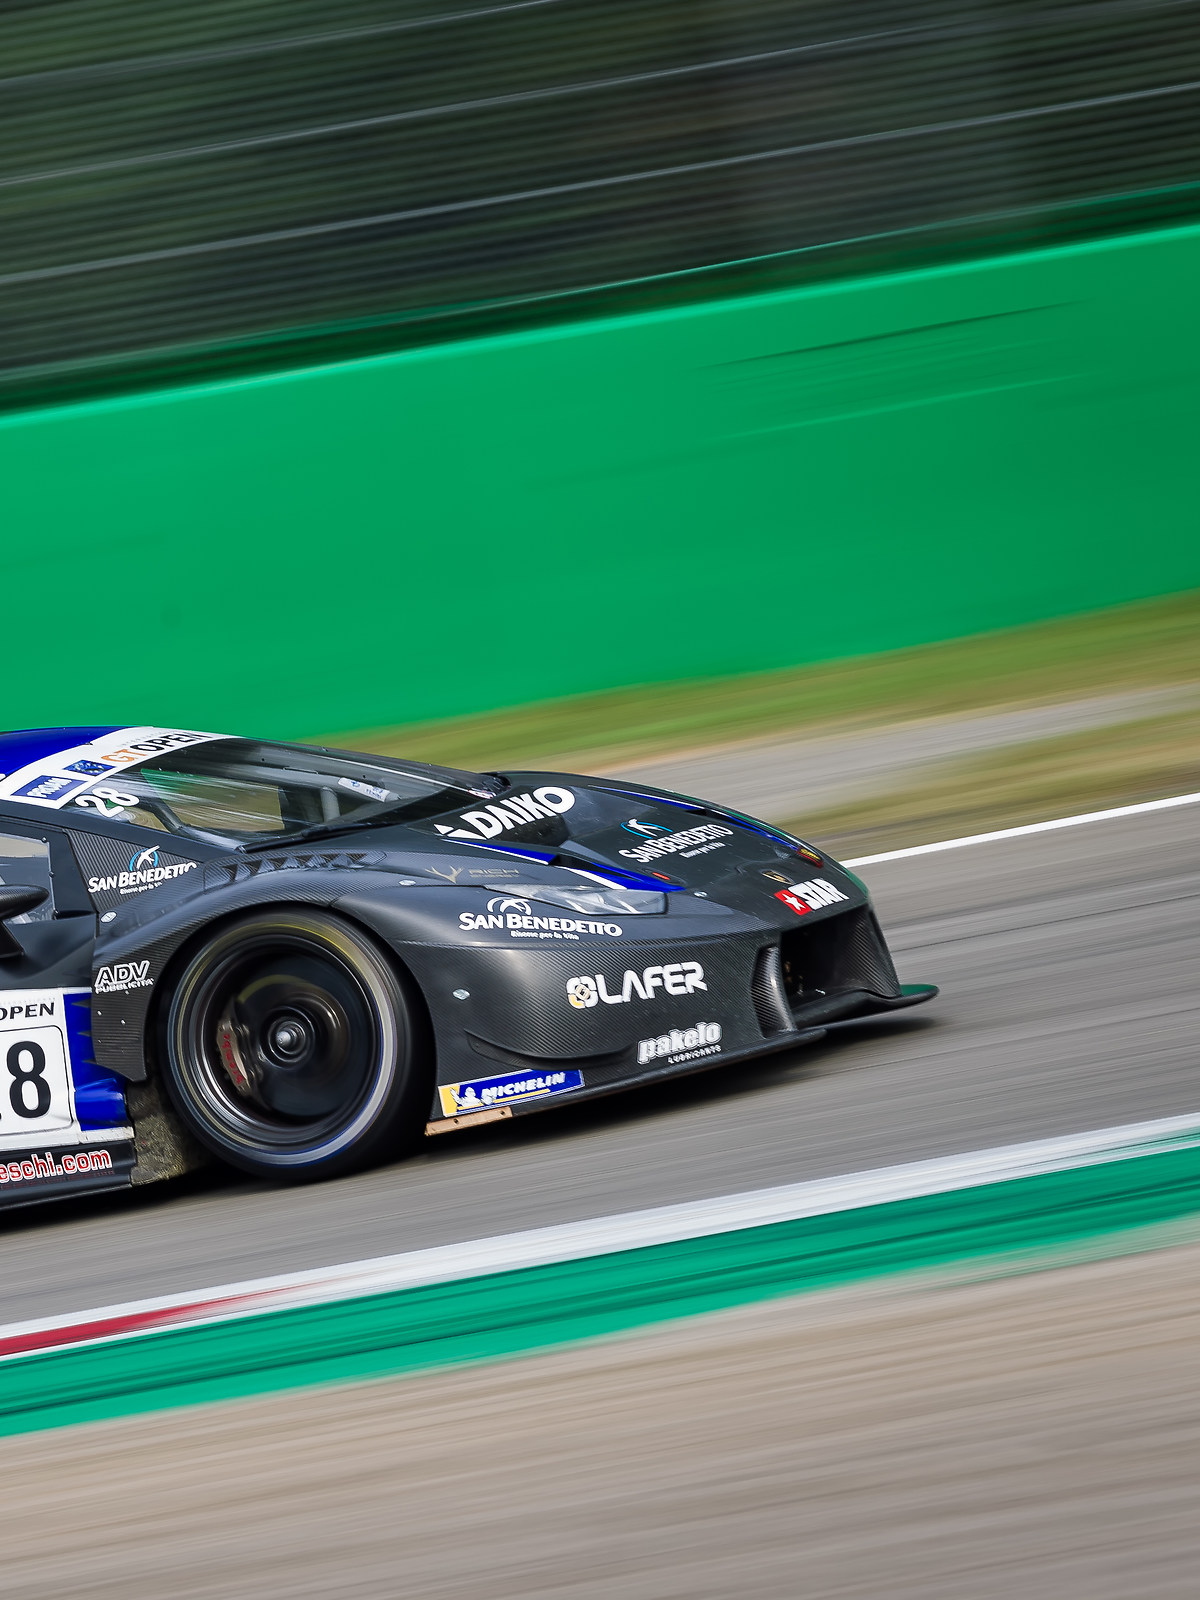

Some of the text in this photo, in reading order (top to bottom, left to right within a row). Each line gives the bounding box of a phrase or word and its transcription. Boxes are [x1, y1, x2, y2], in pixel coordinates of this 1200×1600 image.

[74, 786, 140, 818] 28
[460, 786, 576, 840] DAIKO
[88, 875, 118, 893] SAN
[788, 878, 850, 911] STAR
[458, 912, 623, 937] SAN BENEDETTO
[94, 959, 151, 987] ADV
[637, 1022, 722, 1064] pakelo
[481, 1071, 566, 1100] MICHELIN
